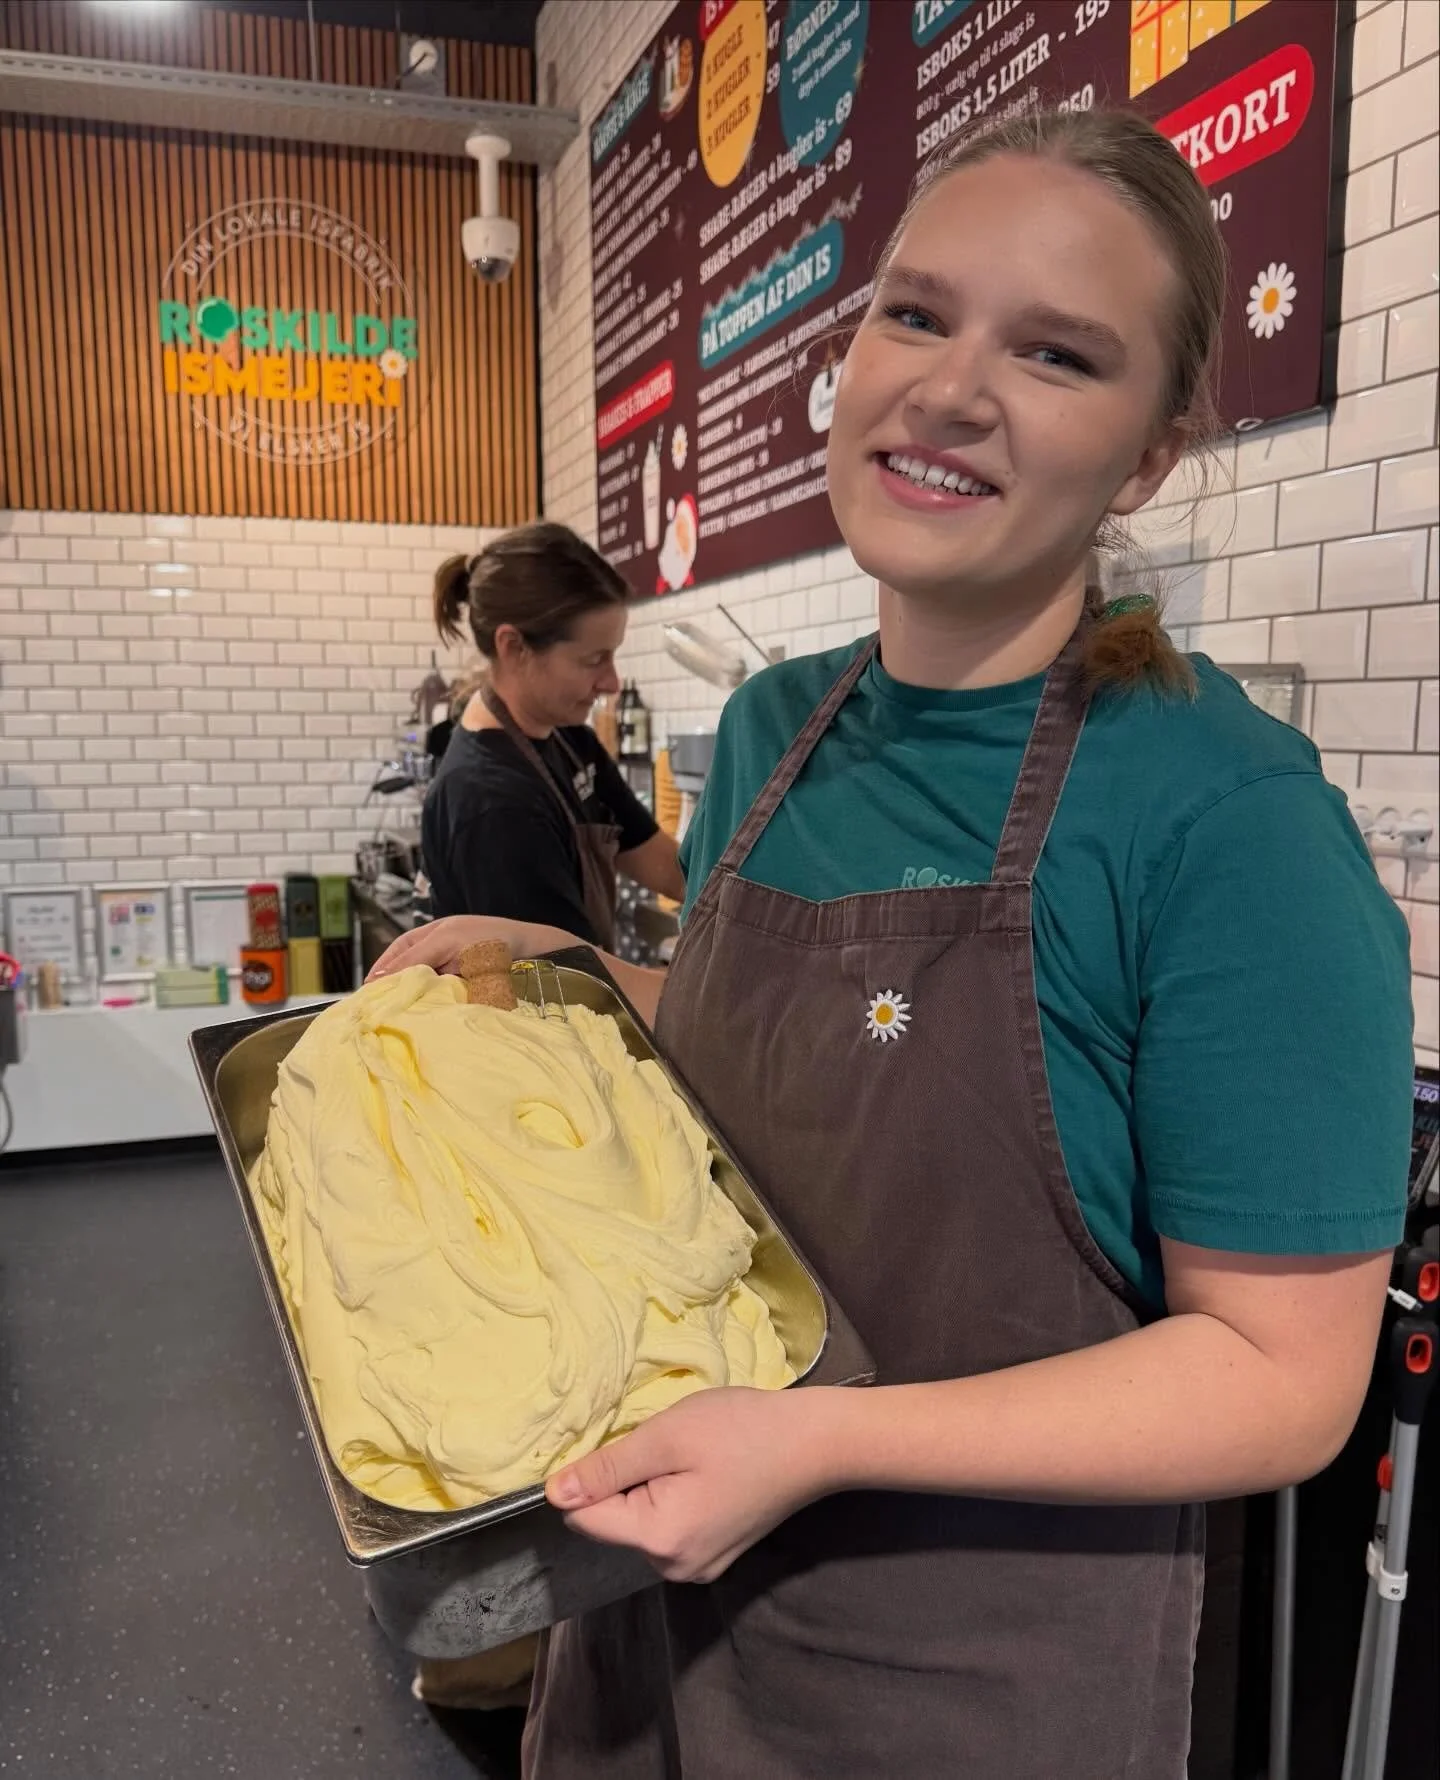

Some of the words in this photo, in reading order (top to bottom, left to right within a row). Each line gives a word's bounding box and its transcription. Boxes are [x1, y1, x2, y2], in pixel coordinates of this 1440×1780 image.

[915, 0, 954, 34] TA
[917, 22, 972, 90] ISBOKS
[975, 12, 985, 40] 1
[713, 56, 750, 111] KUGLER
[916, 94, 972, 159] ISBOKS
[973, 74, 998, 115] 1,5
[1000, 33, 1051, 95] LITER
[713, 96, 751, 149] KUGLER
[768, 161, 777, 184] 4
[776, 131, 815, 180] kugler
[815, 116, 827, 145] is
[835, 91, 853, 125] 69
[214, 207, 301, 243] LOKALE
[768, 203, 777, 228] 6
[776, 174, 815, 222] kugler
[815, 161, 827, 190] is
[159, 297, 419, 359] ROSKILDE
[702, 319, 719, 360] PÅ
[718, 291, 766, 348] TOPPEN
[765, 277, 787, 315] AF
[786, 255, 814, 301] DIN
[814, 243, 832, 281] IS
